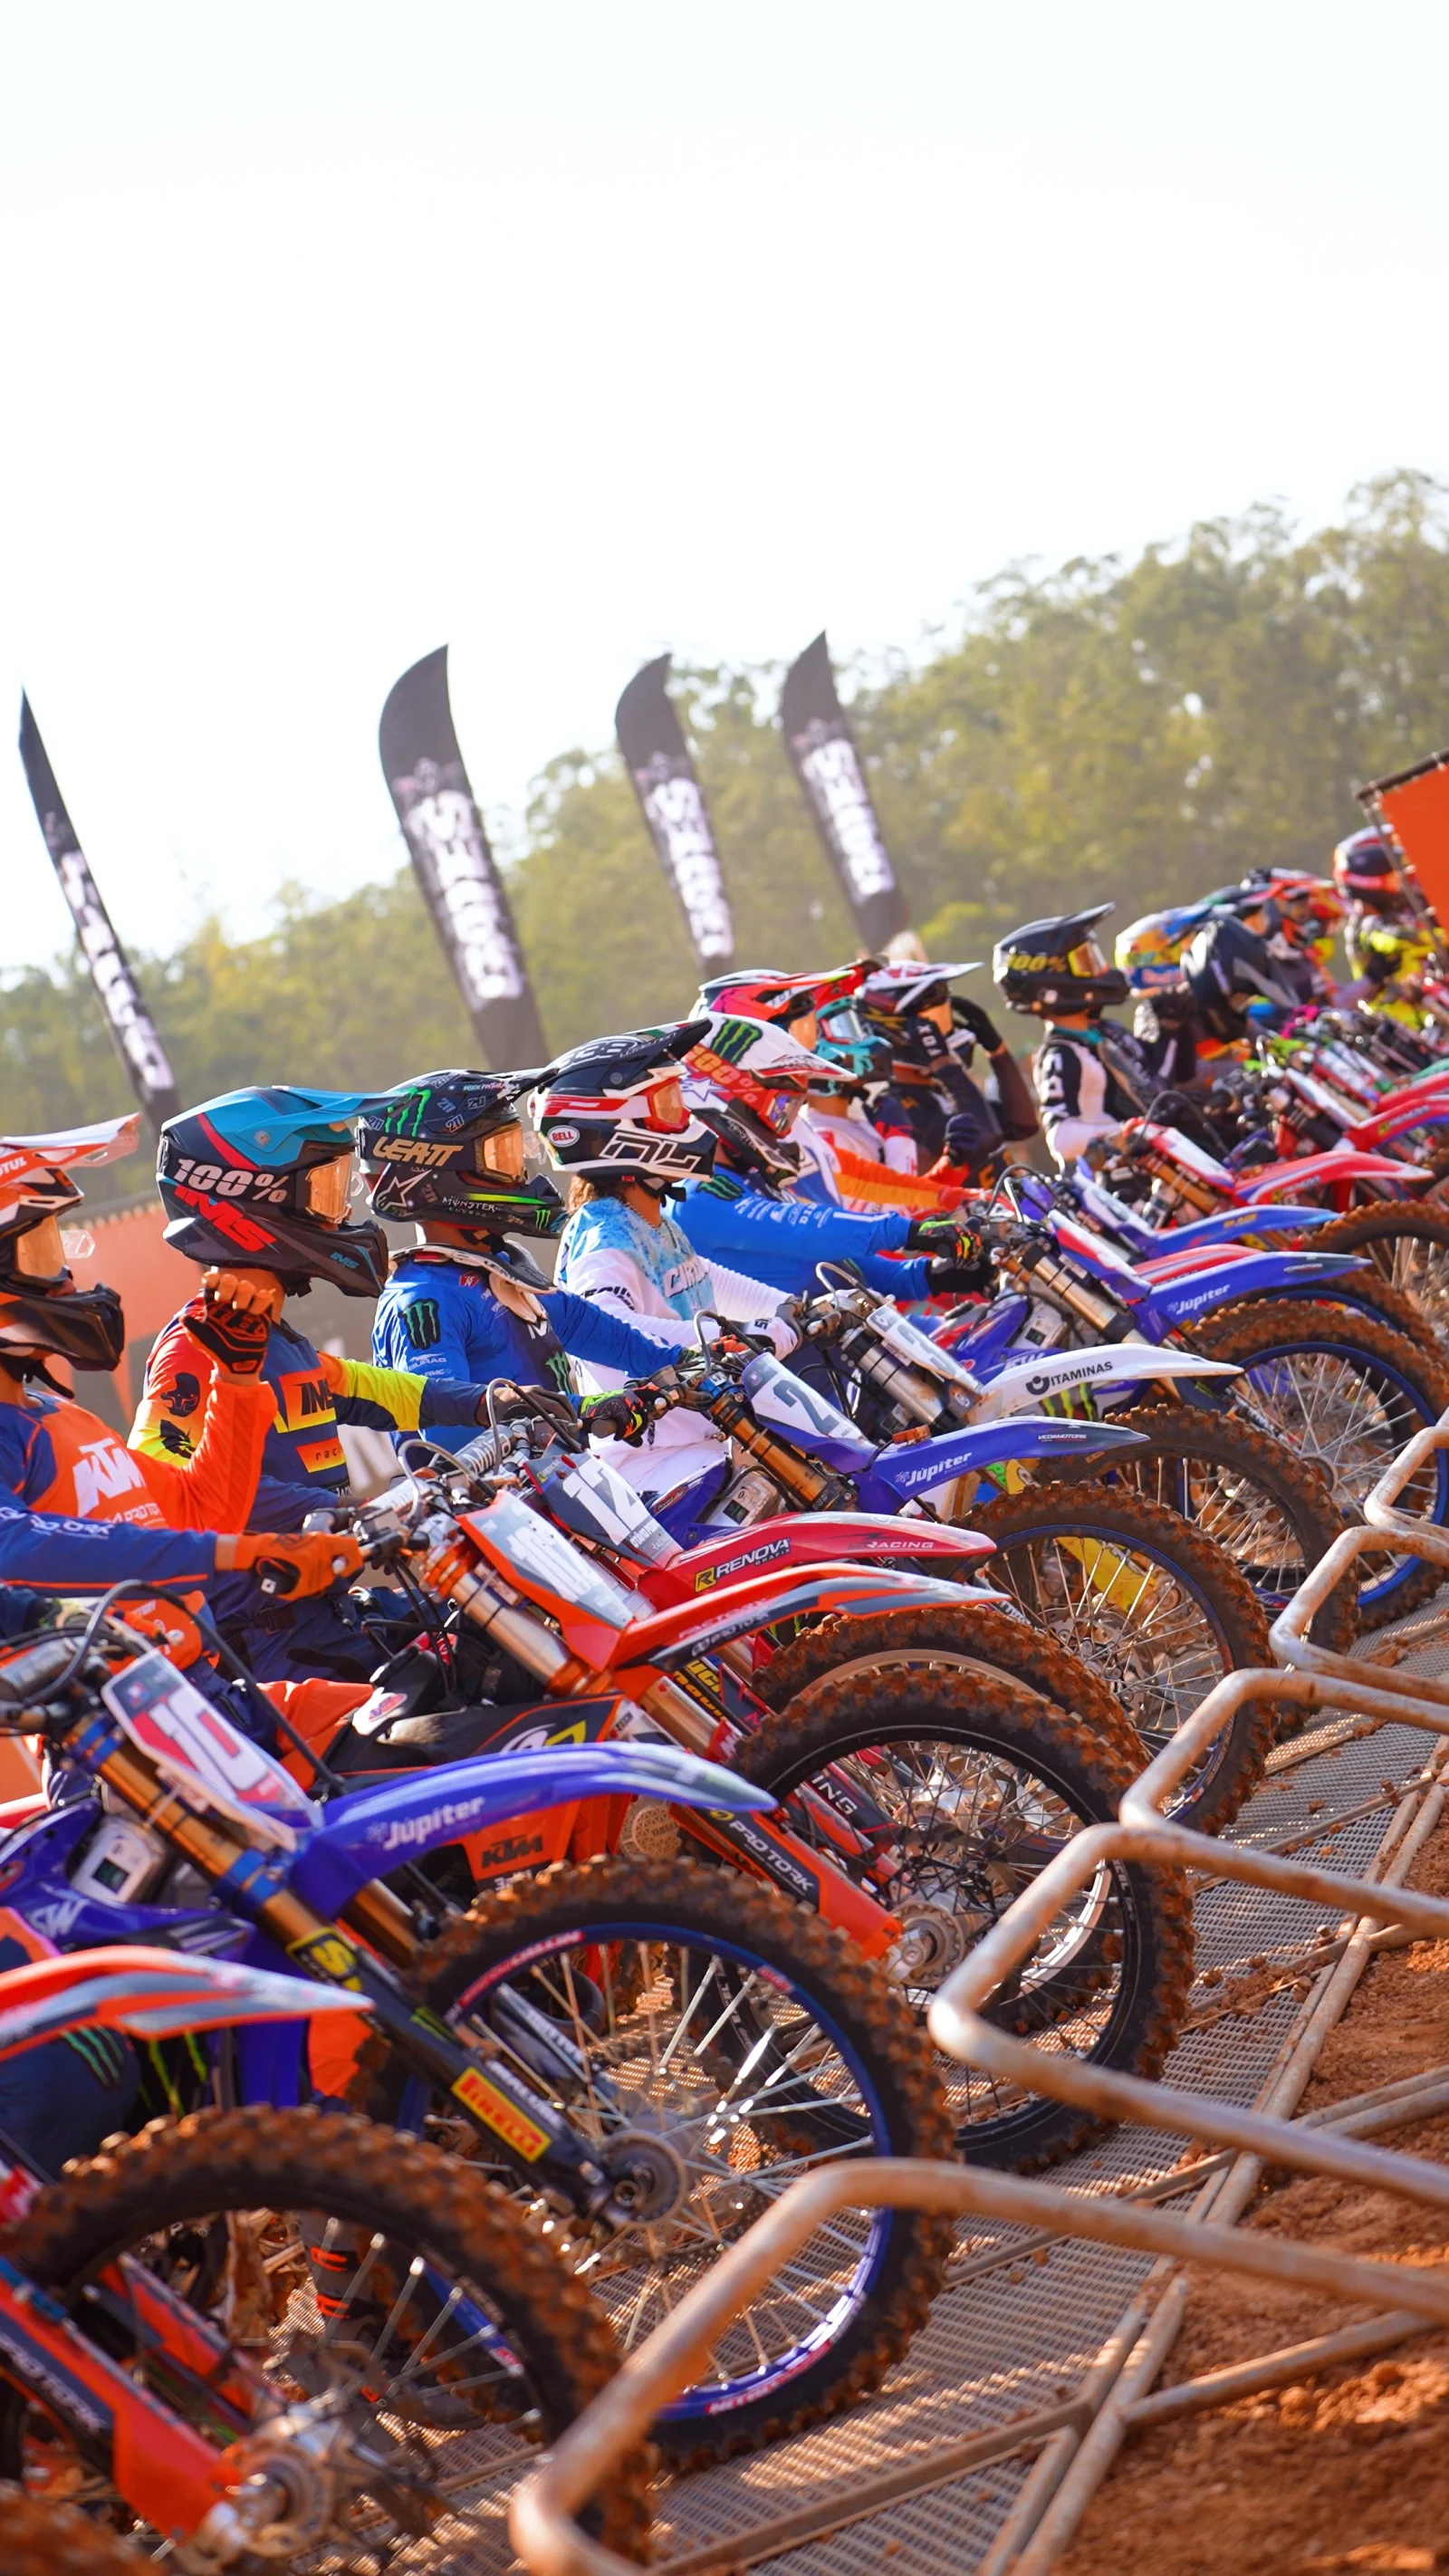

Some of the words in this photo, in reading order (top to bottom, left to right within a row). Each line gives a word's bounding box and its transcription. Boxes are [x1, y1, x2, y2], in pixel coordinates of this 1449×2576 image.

[372, 1136, 465, 1168] LEATT
[552, 1130, 575, 1142] BELL
[0, 1156, 28, 1178] TUL
[173, 1157, 290, 1204] 100%
[772, 1379, 840, 1436] 2
[72, 1437, 147, 1518] KTM
[562, 1452, 651, 1546] 17
[716, 1538, 791, 1580] RENOVA
[149, 1687, 269, 1803] 10
[481, 1833, 543, 1870] KTM
[729, 1820, 770, 1853] PRO
[767, 1852, 814, 1892] TORK
[458, 2074, 543, 2154] PIRELLI
